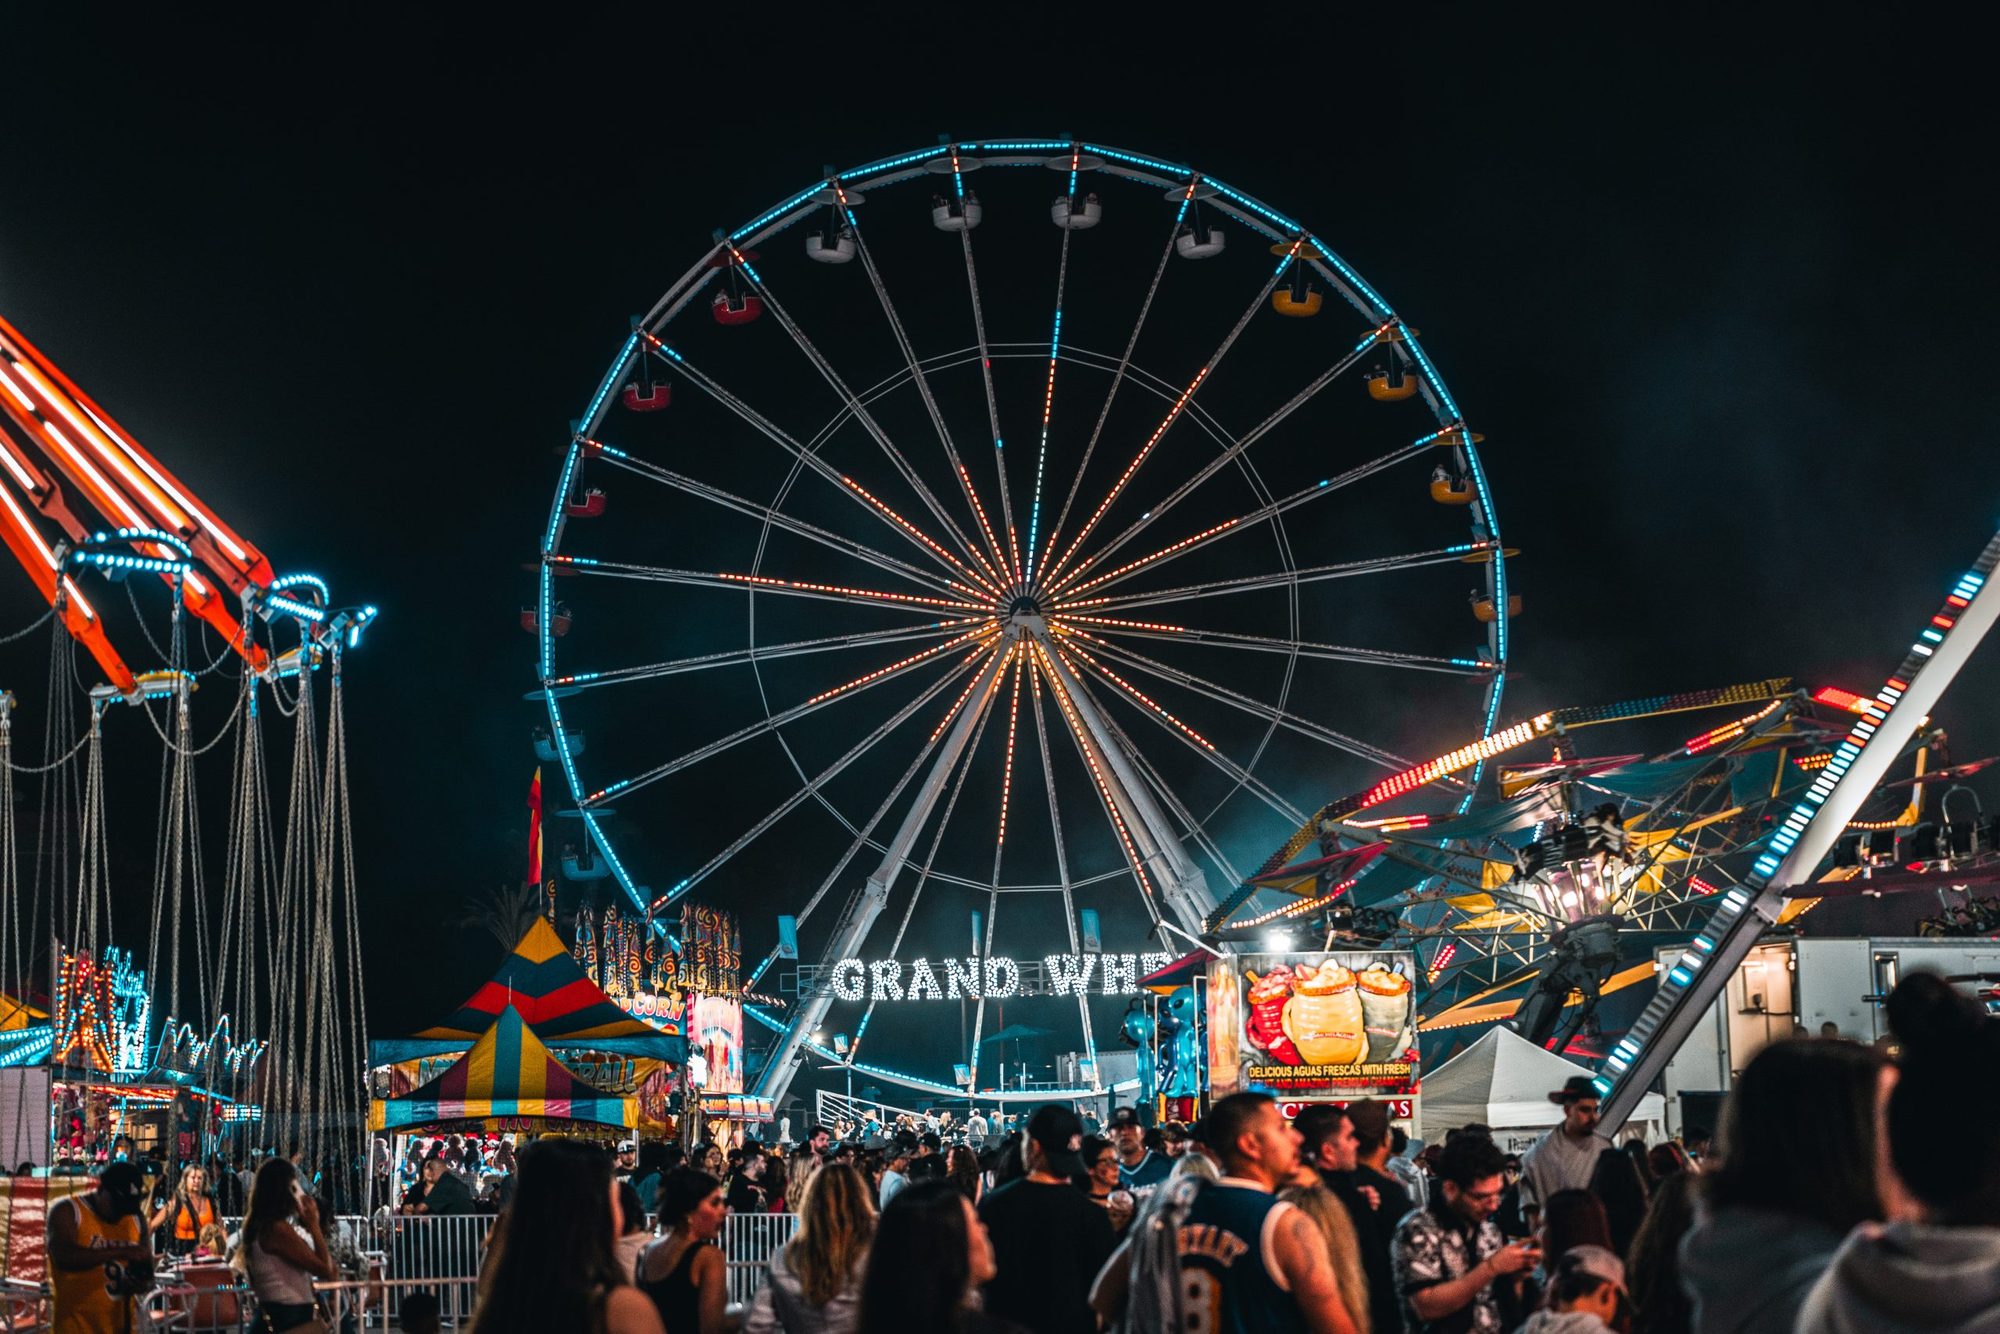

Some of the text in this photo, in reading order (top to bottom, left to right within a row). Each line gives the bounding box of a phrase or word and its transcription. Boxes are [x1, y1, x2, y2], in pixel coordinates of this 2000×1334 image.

[831, 957, 1020, 1000] GRAND
[1249, 1063, 1411, 1078] DELICIOUS AGUAS FRESCAS WITH FRESH
